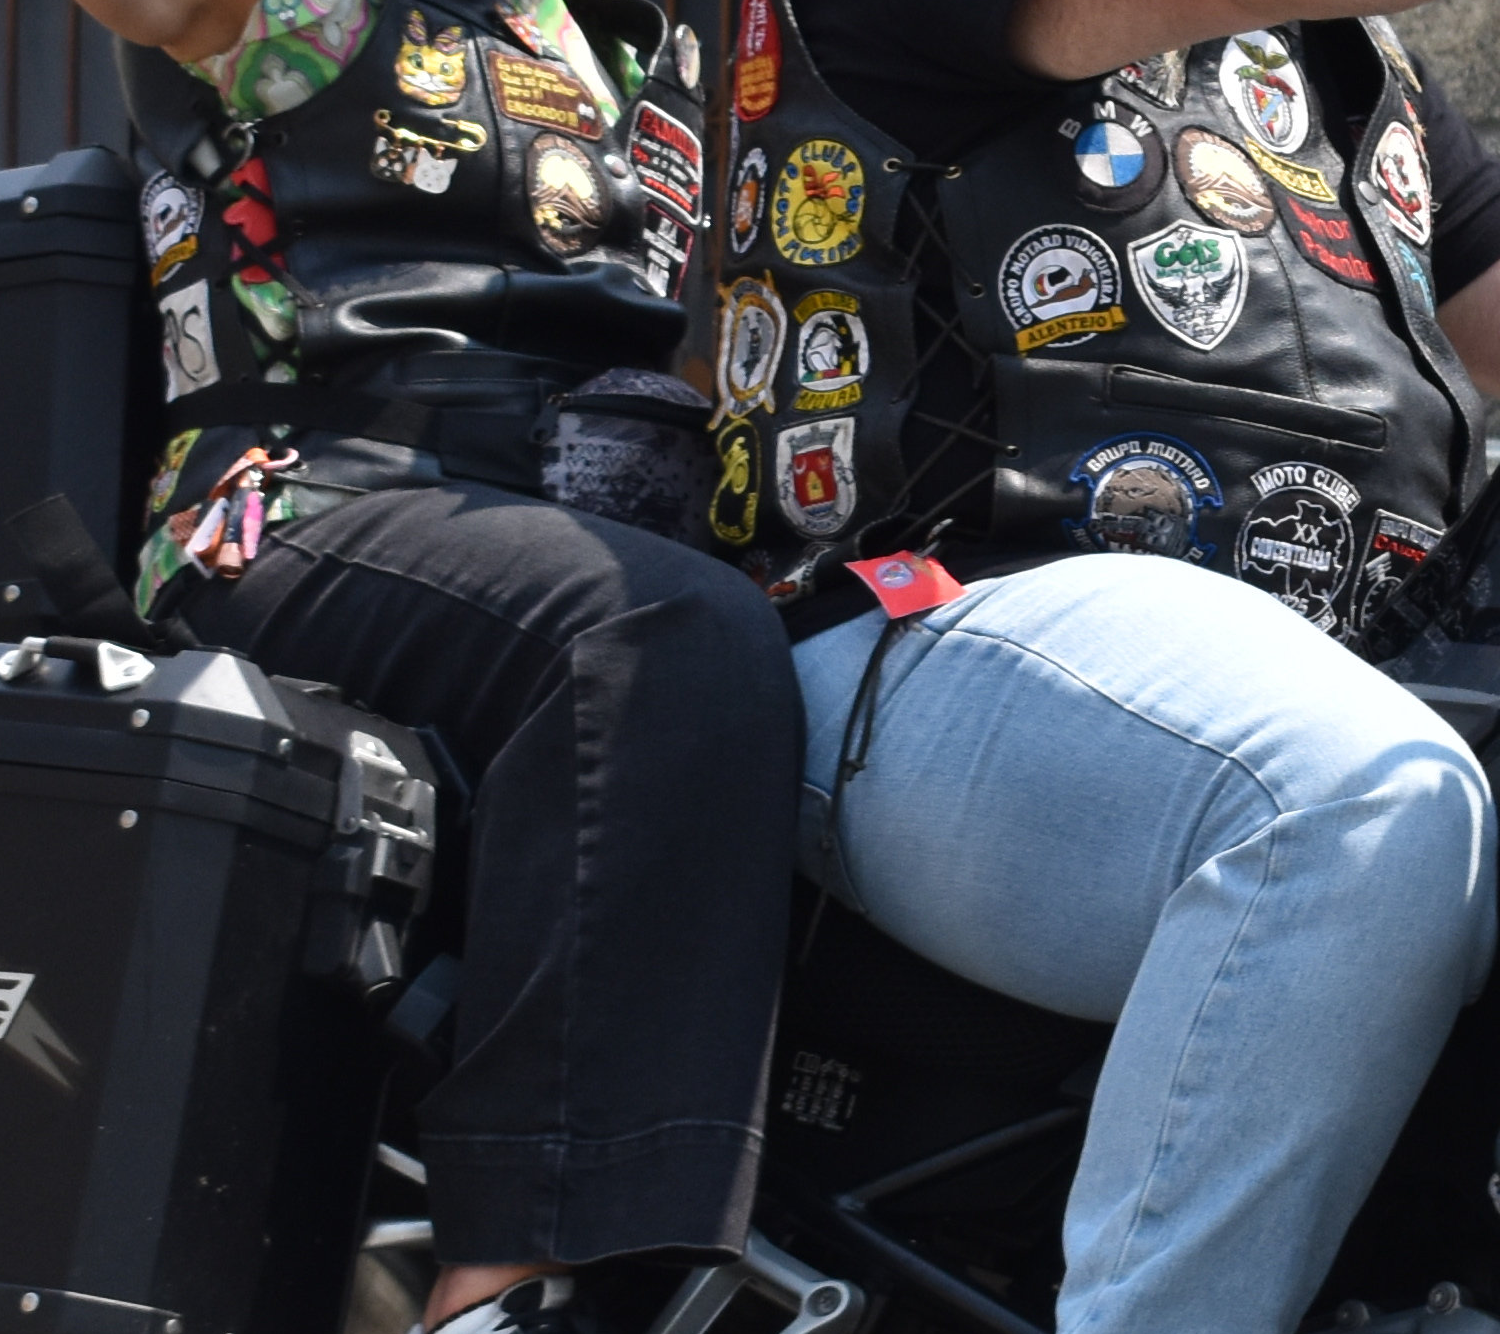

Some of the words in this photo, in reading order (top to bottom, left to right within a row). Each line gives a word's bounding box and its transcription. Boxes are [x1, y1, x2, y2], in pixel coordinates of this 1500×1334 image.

[1057, 99, 1155, 141] BMW
[1009, 233, 1063, 276] MOTARD
[1064, 234, 1116, 306] VIDIGUEIRA
[1006, 277, 1034, 326] GRUPO
[1026, 314, 1108, 344] ALENTEJO
[1086, 439, 1142, 473] GRUPO
[1146, 440, 1211, 490] MOTARD
[1257, 466, 1307, 495] MOTO
[1312, 469, 1360, 511] CLUBE
[1292, 521, 1324, 547] XX
